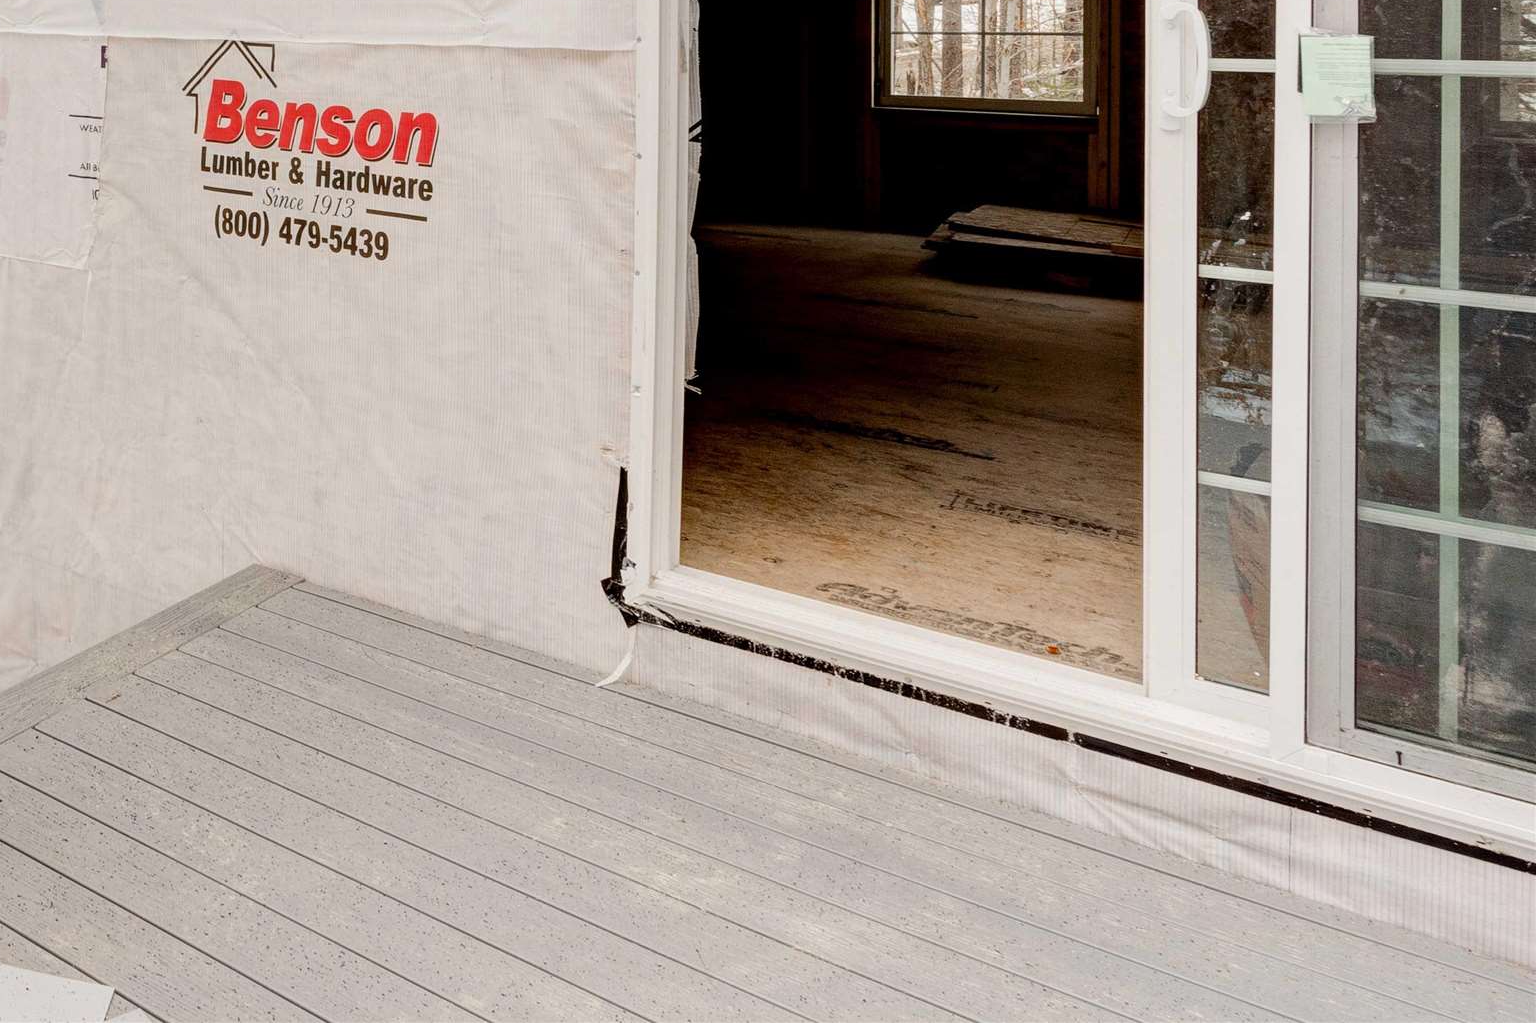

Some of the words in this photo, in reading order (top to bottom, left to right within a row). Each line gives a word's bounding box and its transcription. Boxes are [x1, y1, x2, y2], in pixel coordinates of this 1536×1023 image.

[80, 124, 103, 134] WEAT
[203, 78, 439, 167] Benson
[201, 146, 279, 182] Lumber
[288, 156, 304, 185] &
[316, 160, 433, 202] Hardware
[262, 185, 304, 211] Since
[311, 194, 356, 218] 1913
[214, 204, 270, 247] (800)
[278, 216, 390, 261] 479-5439
